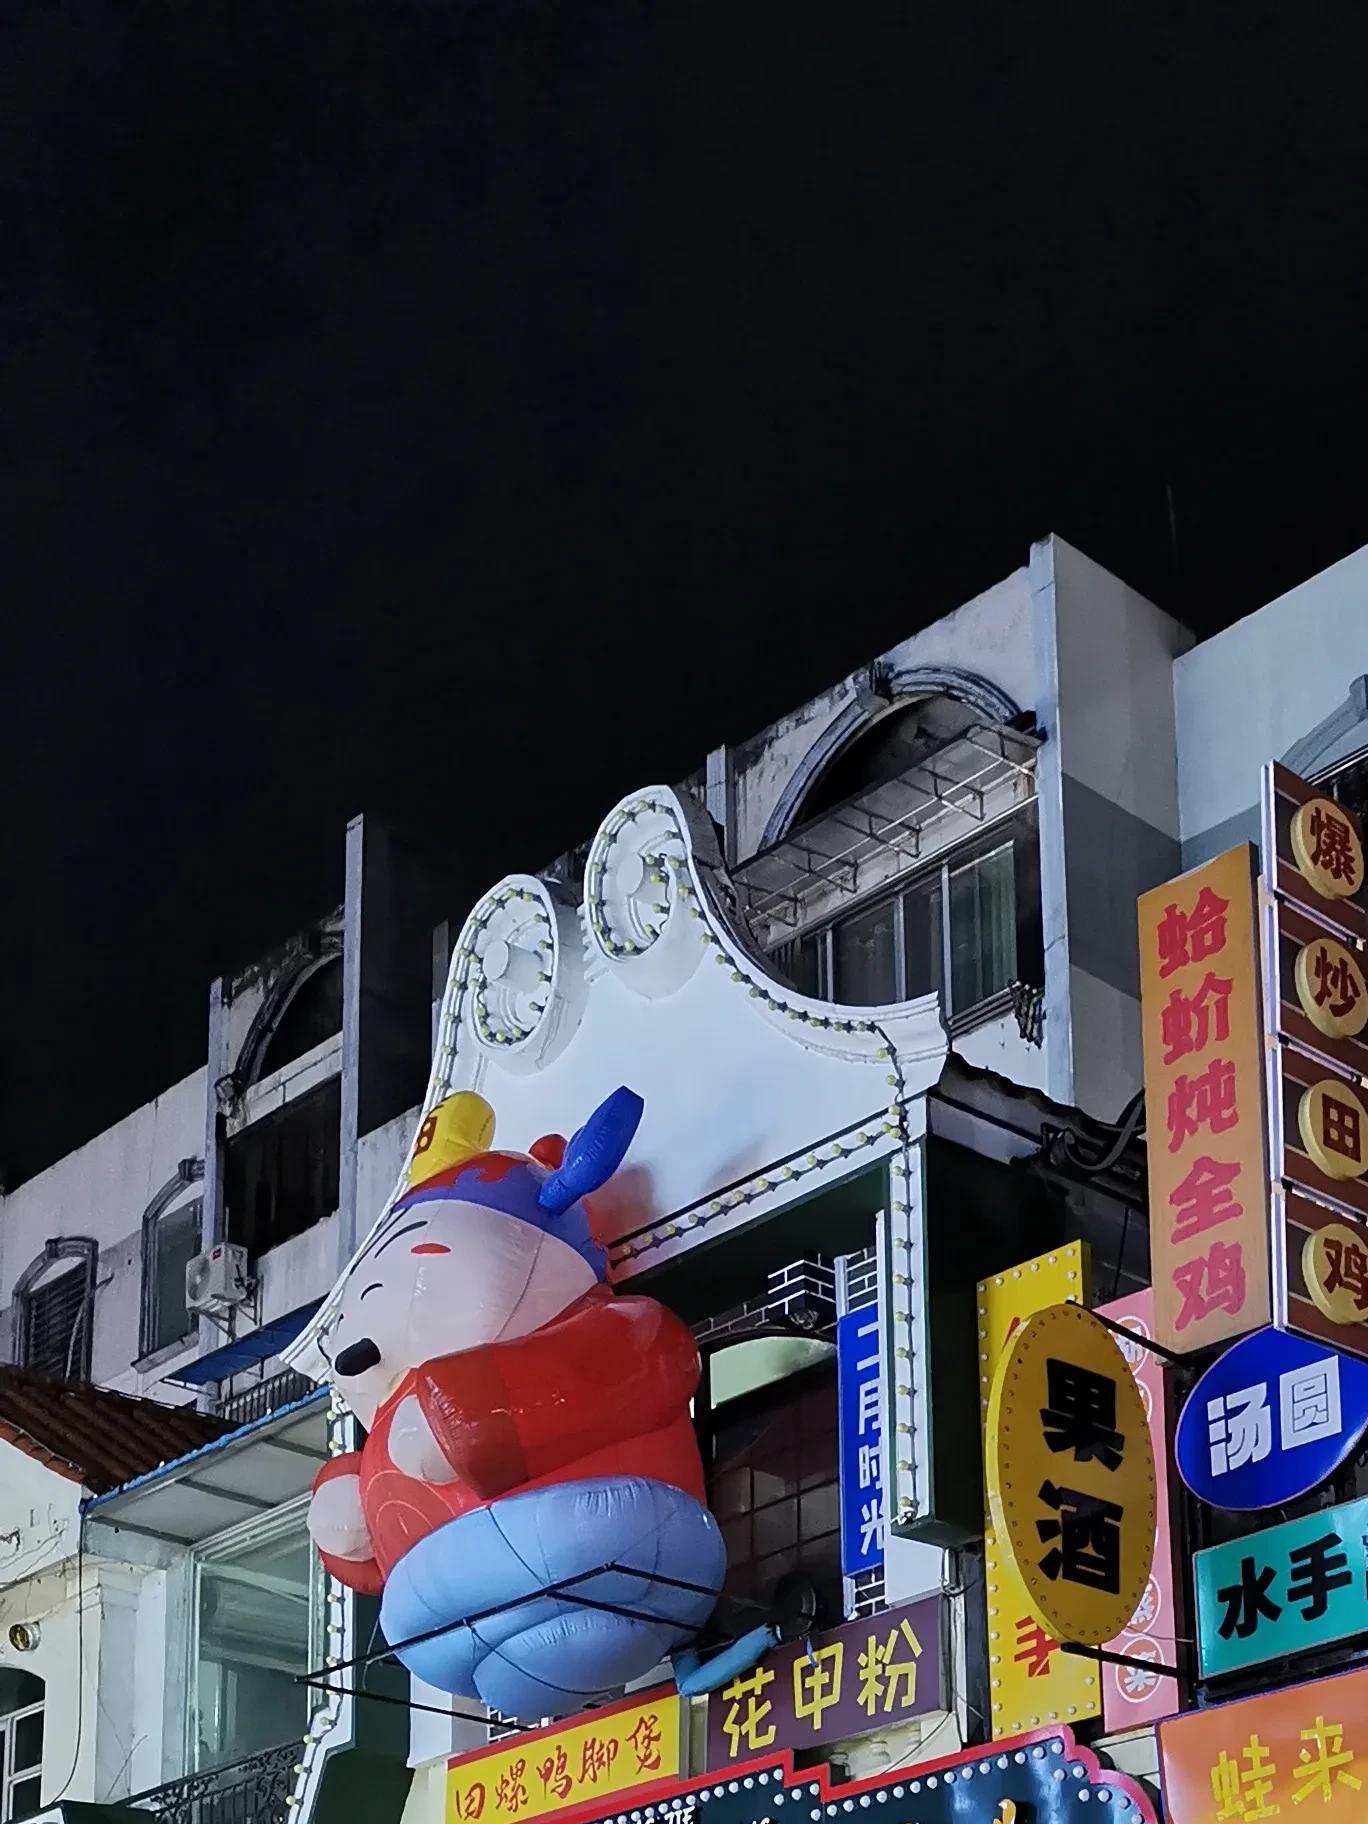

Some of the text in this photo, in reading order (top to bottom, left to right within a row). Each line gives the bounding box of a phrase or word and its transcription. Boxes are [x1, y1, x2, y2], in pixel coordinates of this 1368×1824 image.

[1156, 886, 1247, 1331] 蛤蚧炖全鸡
[1036, 1357, 1124, 1594] 果酒
[1207, 1355, 1342, 1477] 汤圆
[722, 1619, 923, 1758] 花甲粉
